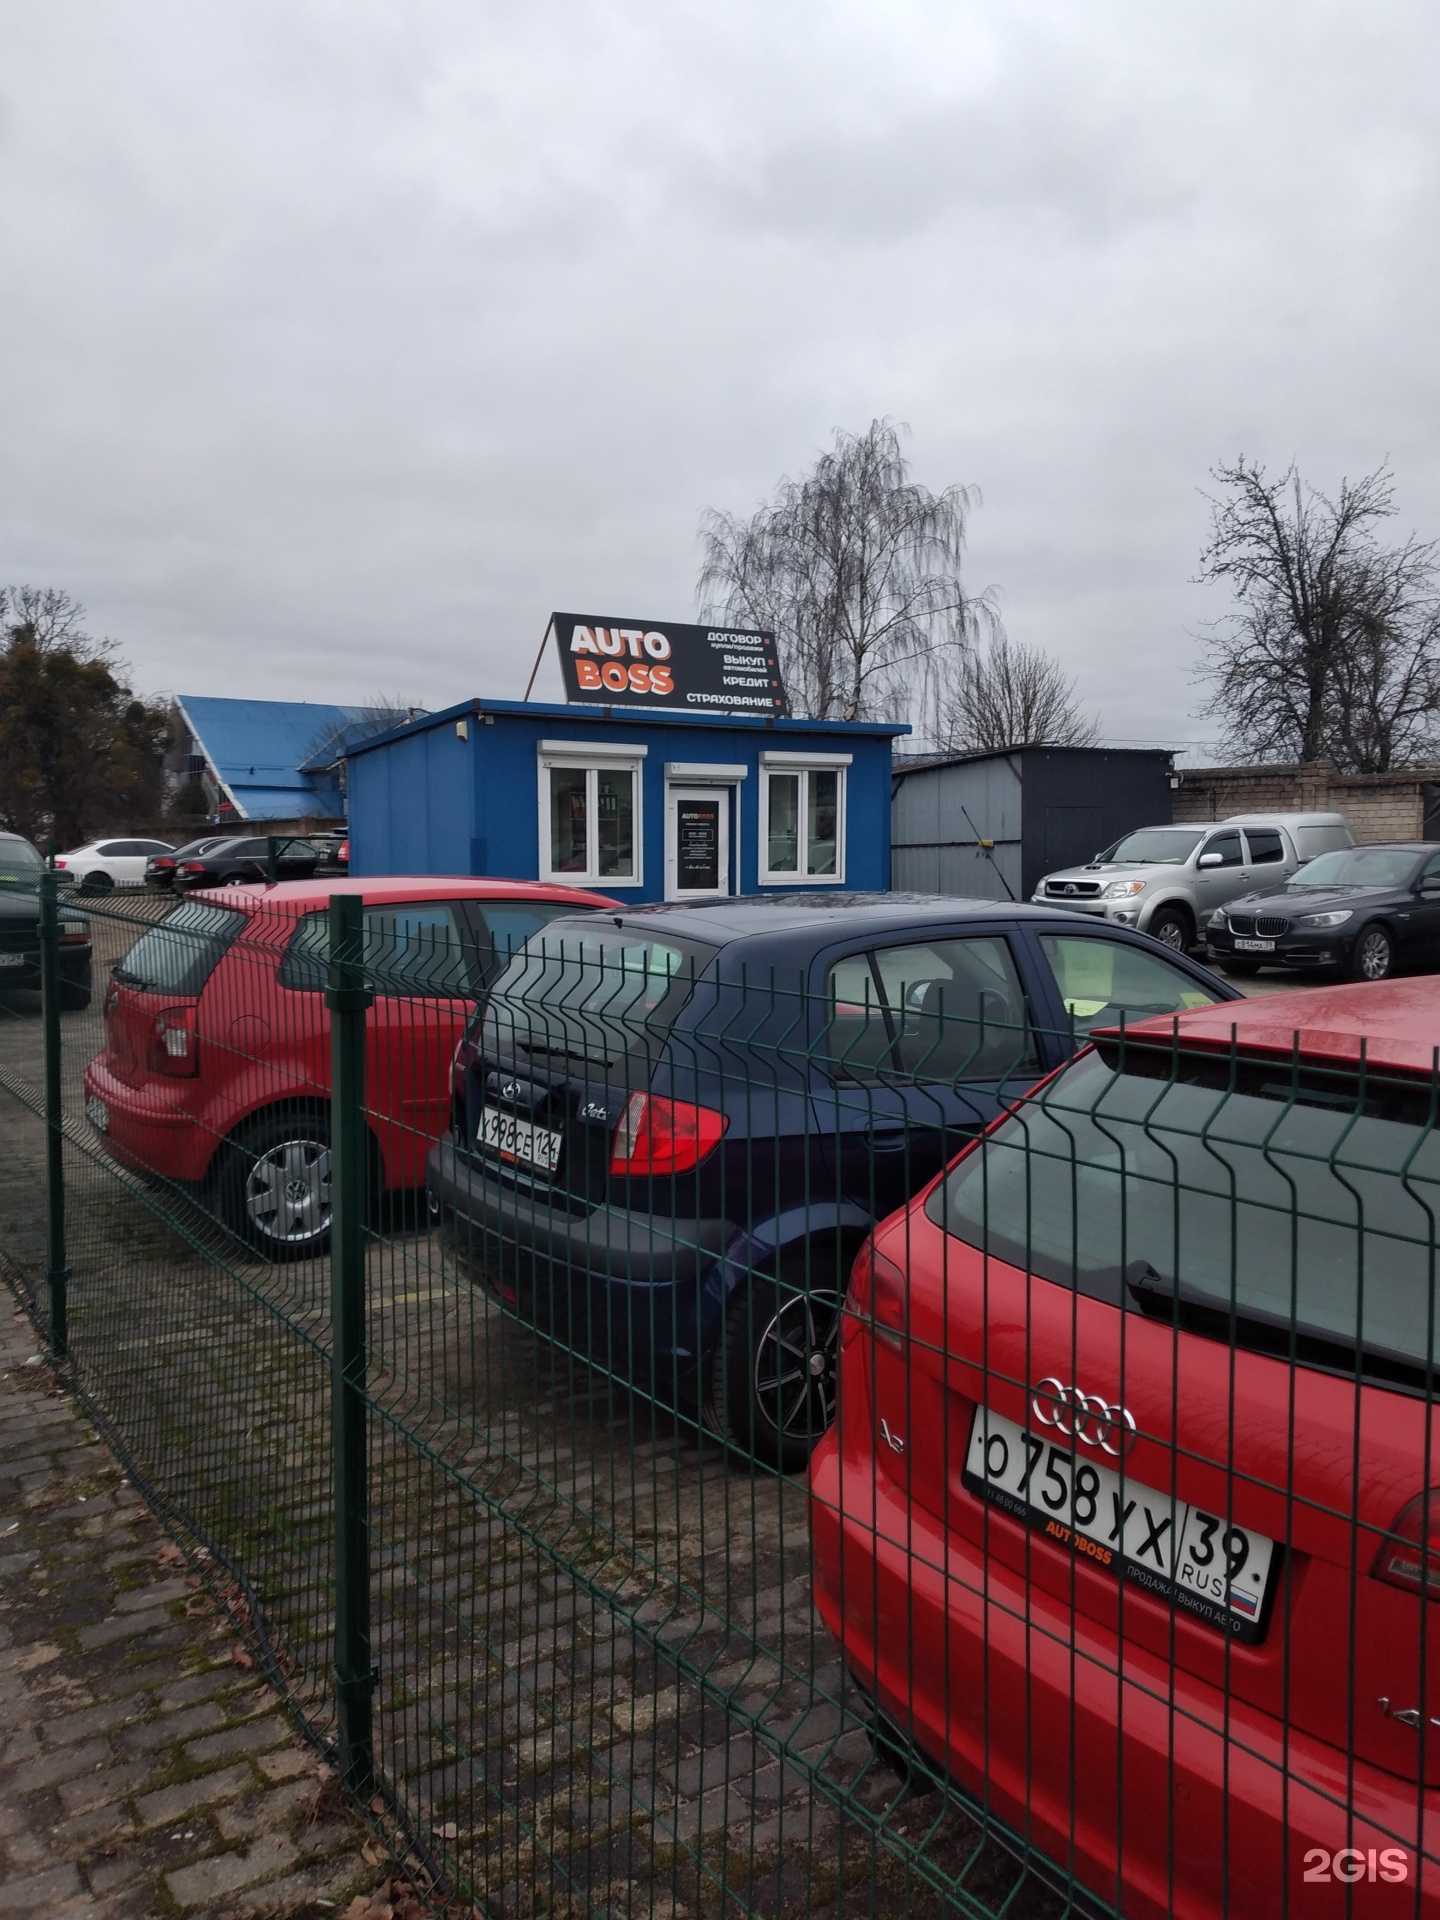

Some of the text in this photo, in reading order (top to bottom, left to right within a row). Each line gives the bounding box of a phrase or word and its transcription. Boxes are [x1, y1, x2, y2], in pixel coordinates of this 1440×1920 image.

[570, 625, 672, 660] AUTO
[707, 632, 762, 645] ДОГОВОР
[723, 654, 766, 666] ВЫКУП
[575, 659, 674, 695] BOSS
[723, 676, 769, 688] КРЕДИТ
[686, 693, 774, 707] СТРАХОВАНИЕ
[1181, 1562, 1224, 1598] RUS
[1178, 1593, 1214, 1618] ВЫКУП
